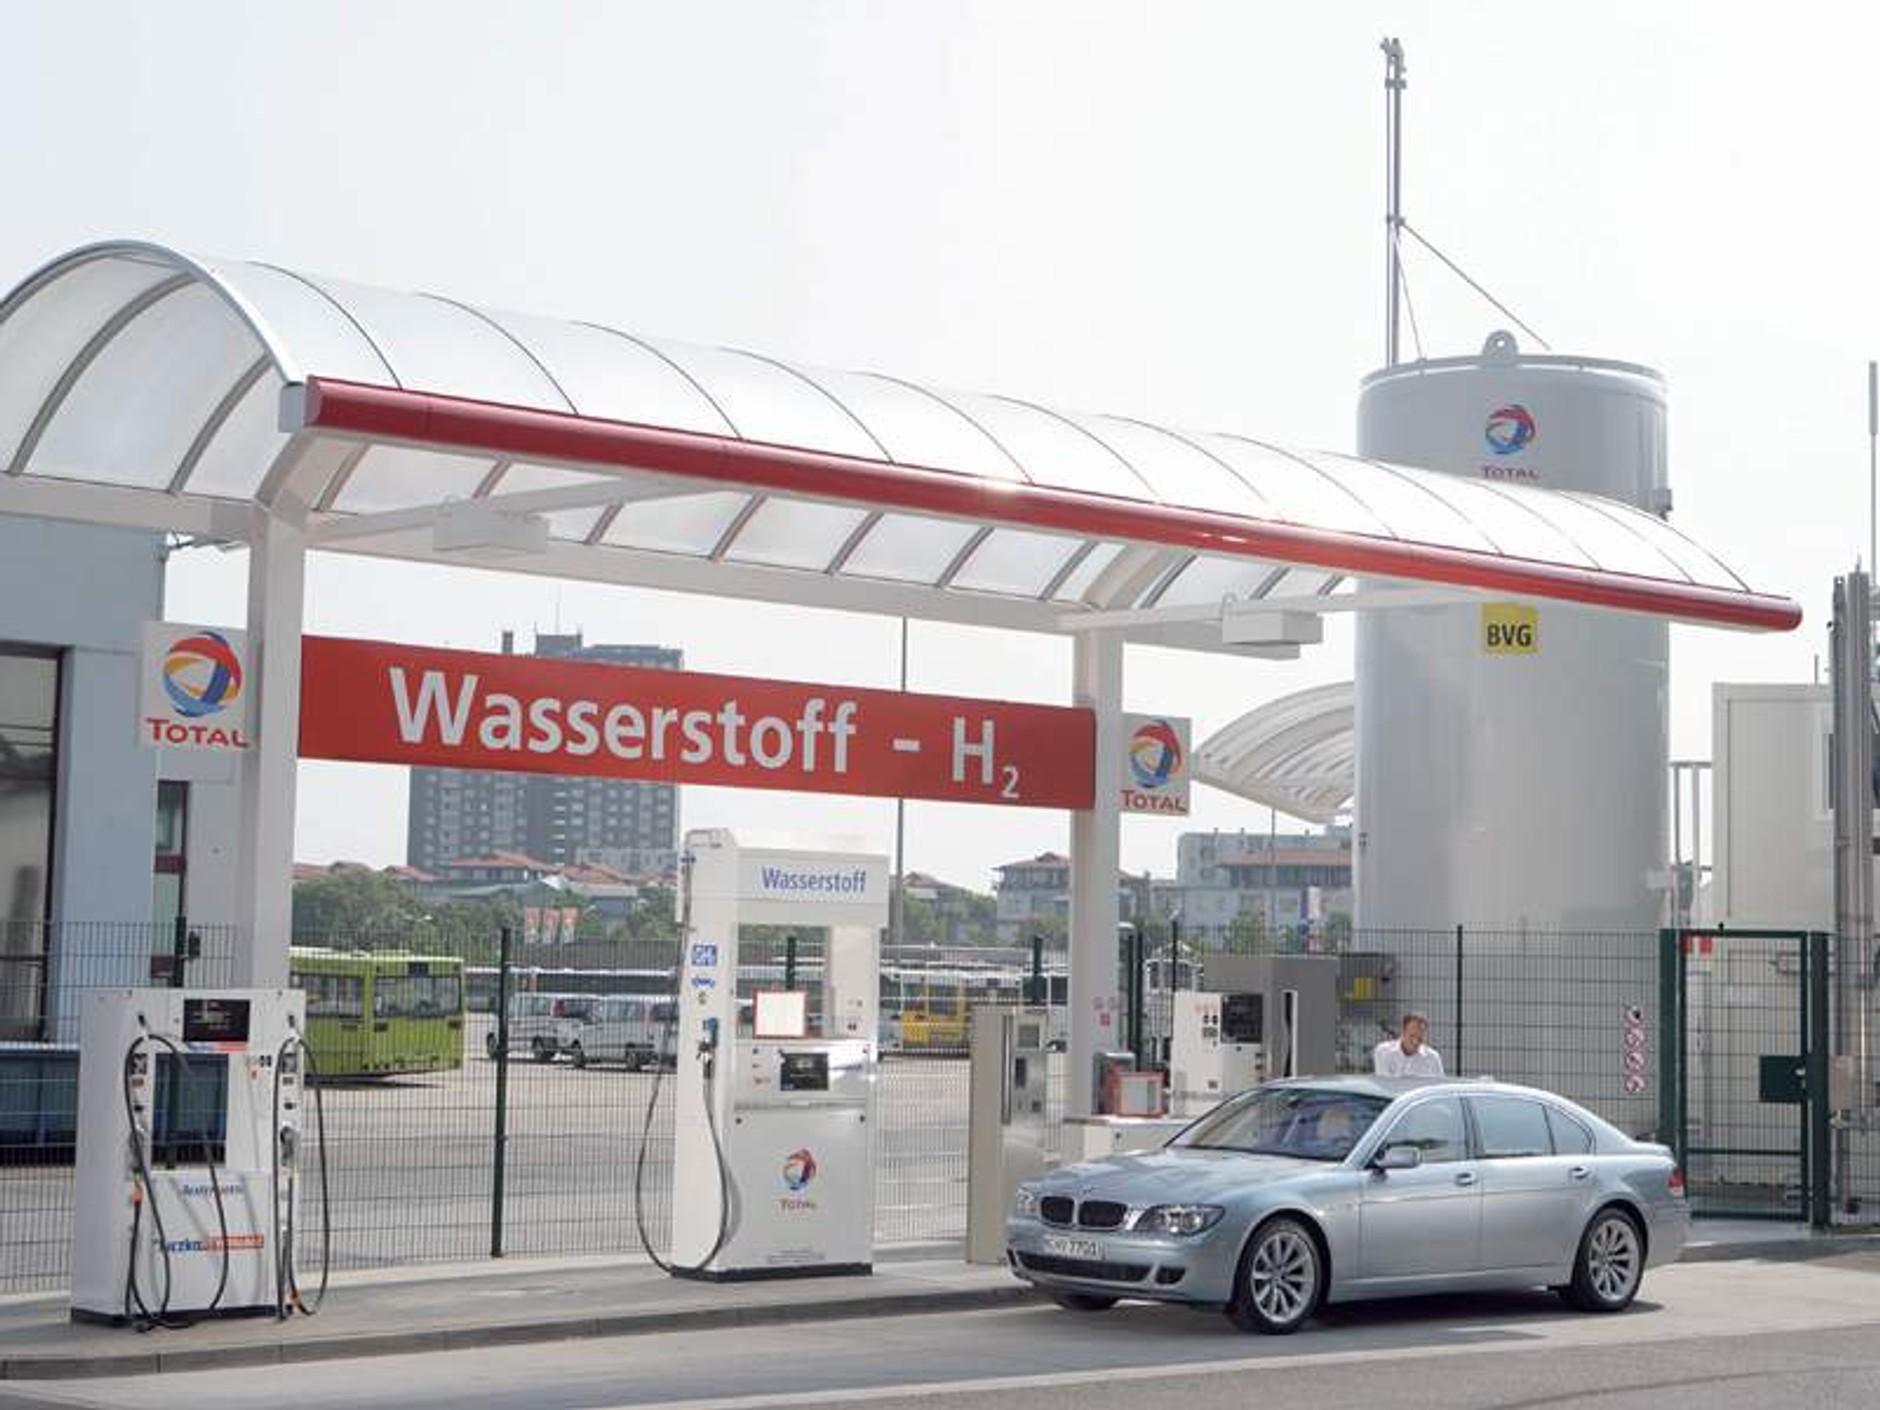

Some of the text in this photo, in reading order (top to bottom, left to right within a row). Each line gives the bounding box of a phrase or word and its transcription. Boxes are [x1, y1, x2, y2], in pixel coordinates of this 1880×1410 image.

[1482, 465, 1540, 480] TOTAL
[1487, 623, 1532, 647] BVG
[145, 717, 249, 748] TOTAL
[389, 667, 857, 773] Wasserstoff
[1120, 790, 1187, 812] TOTAL
[761, 865, 866, 893] Wasserstoff
